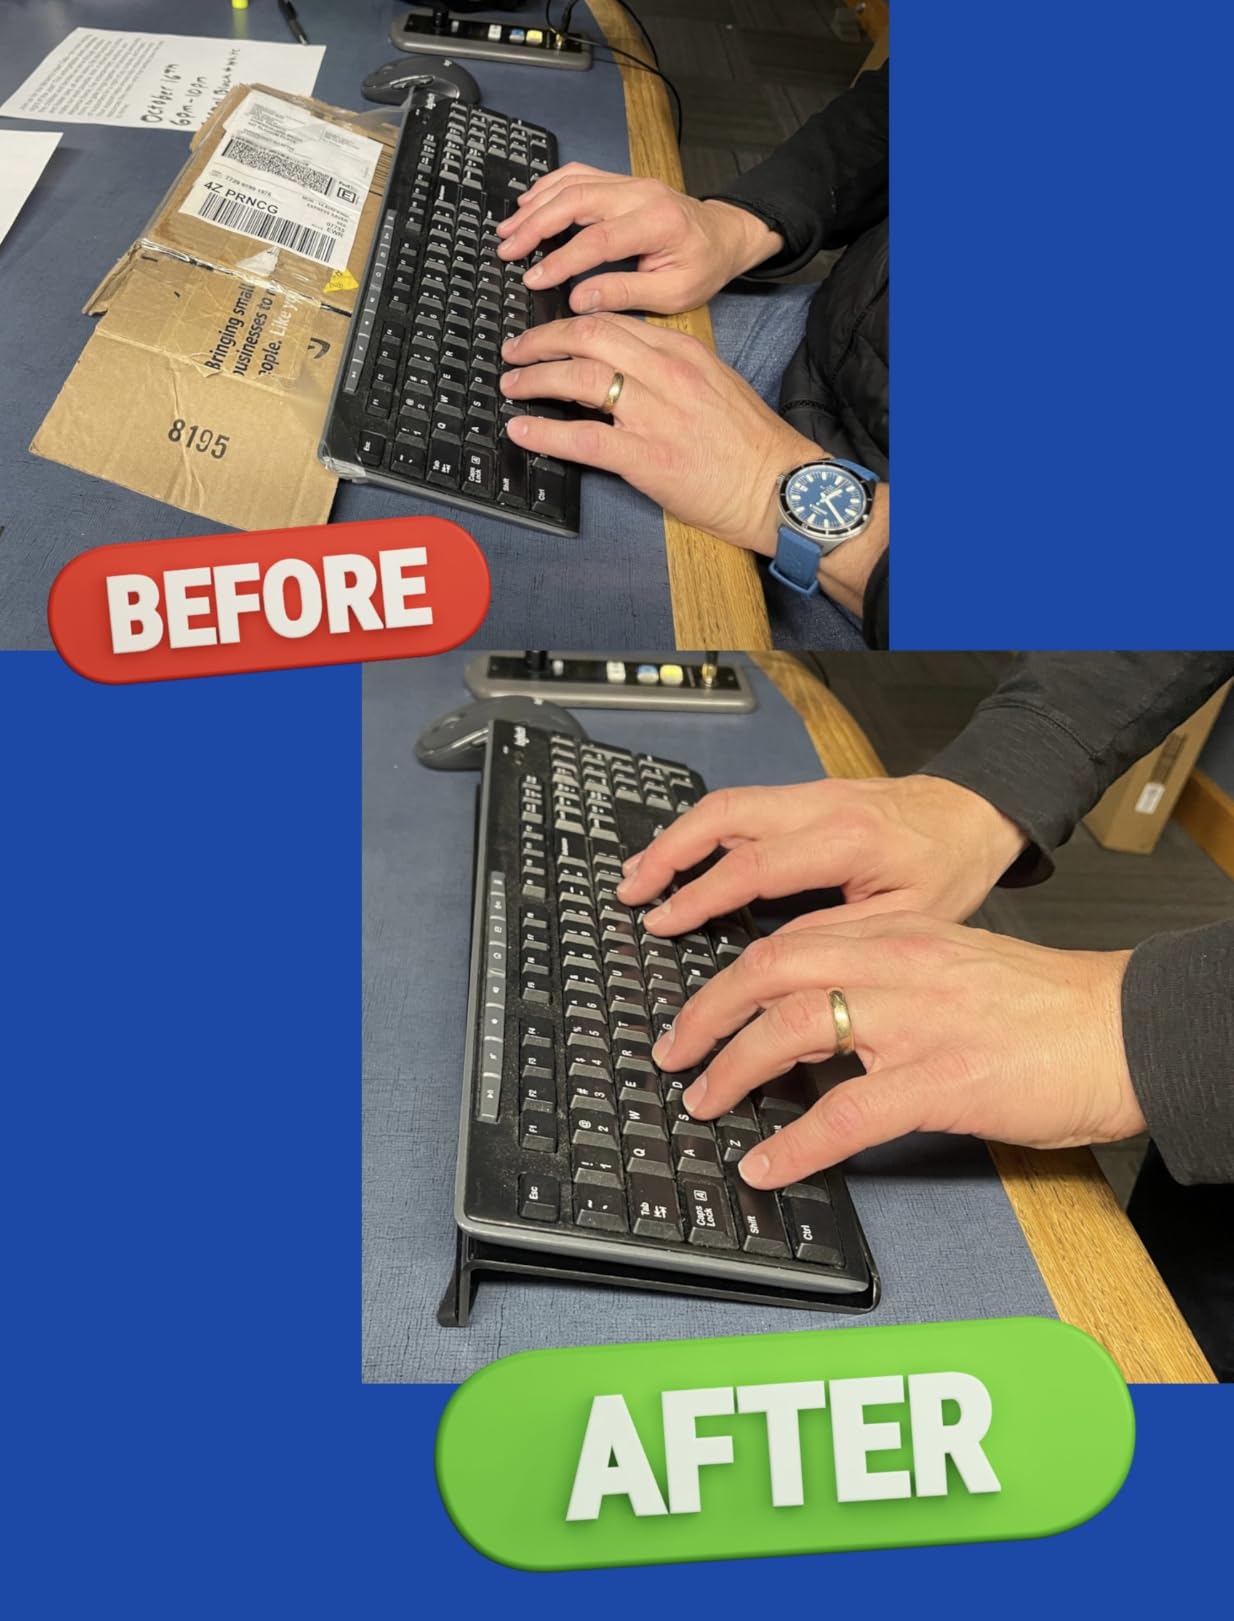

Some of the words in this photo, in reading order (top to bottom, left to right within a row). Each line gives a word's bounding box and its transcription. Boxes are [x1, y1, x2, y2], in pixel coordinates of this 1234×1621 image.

[140, 86, 173, 123] October
[204, 181, 224, 194] 4Z
[225, 188, 279, 214] PRNCG
[257, 297, 273, 312] to
[204, 316, 245, 370] Bringing
[232, 283, 256, 316] small
[270, 311, 292, 337] Like
[440, 394, 449, 404] W
[168, 419, 230, 459] 8195
[614, 994, 626, 1002] Y
[656, 996, 668, 1004] H
[621, 1049, 633, 1057] R
[625, 1080, 637, 1088] E
[672, 1080, 684, 1089] D
[528, 1089, 538, 1098] F2
[628, 1110, 641, 1120] W
[678, 1113, 690, 1122] S
[528, 1124, 538, 1134] F1
[730, 1139, 742, 1148] Z
[633, 1148, 646, 1157] Q
[683, 1148, 696, 1158] A
[528, 1186, 538, 1200] Esc
[640, 1202, 650, 1216] Tab
[695, 1206, 706, 1226] Caps
[704, 1208, 716, 1228] Lock
[747, 1216, 760, 1234] Shift
[800, 1224, 813, 1241] Ctrl
